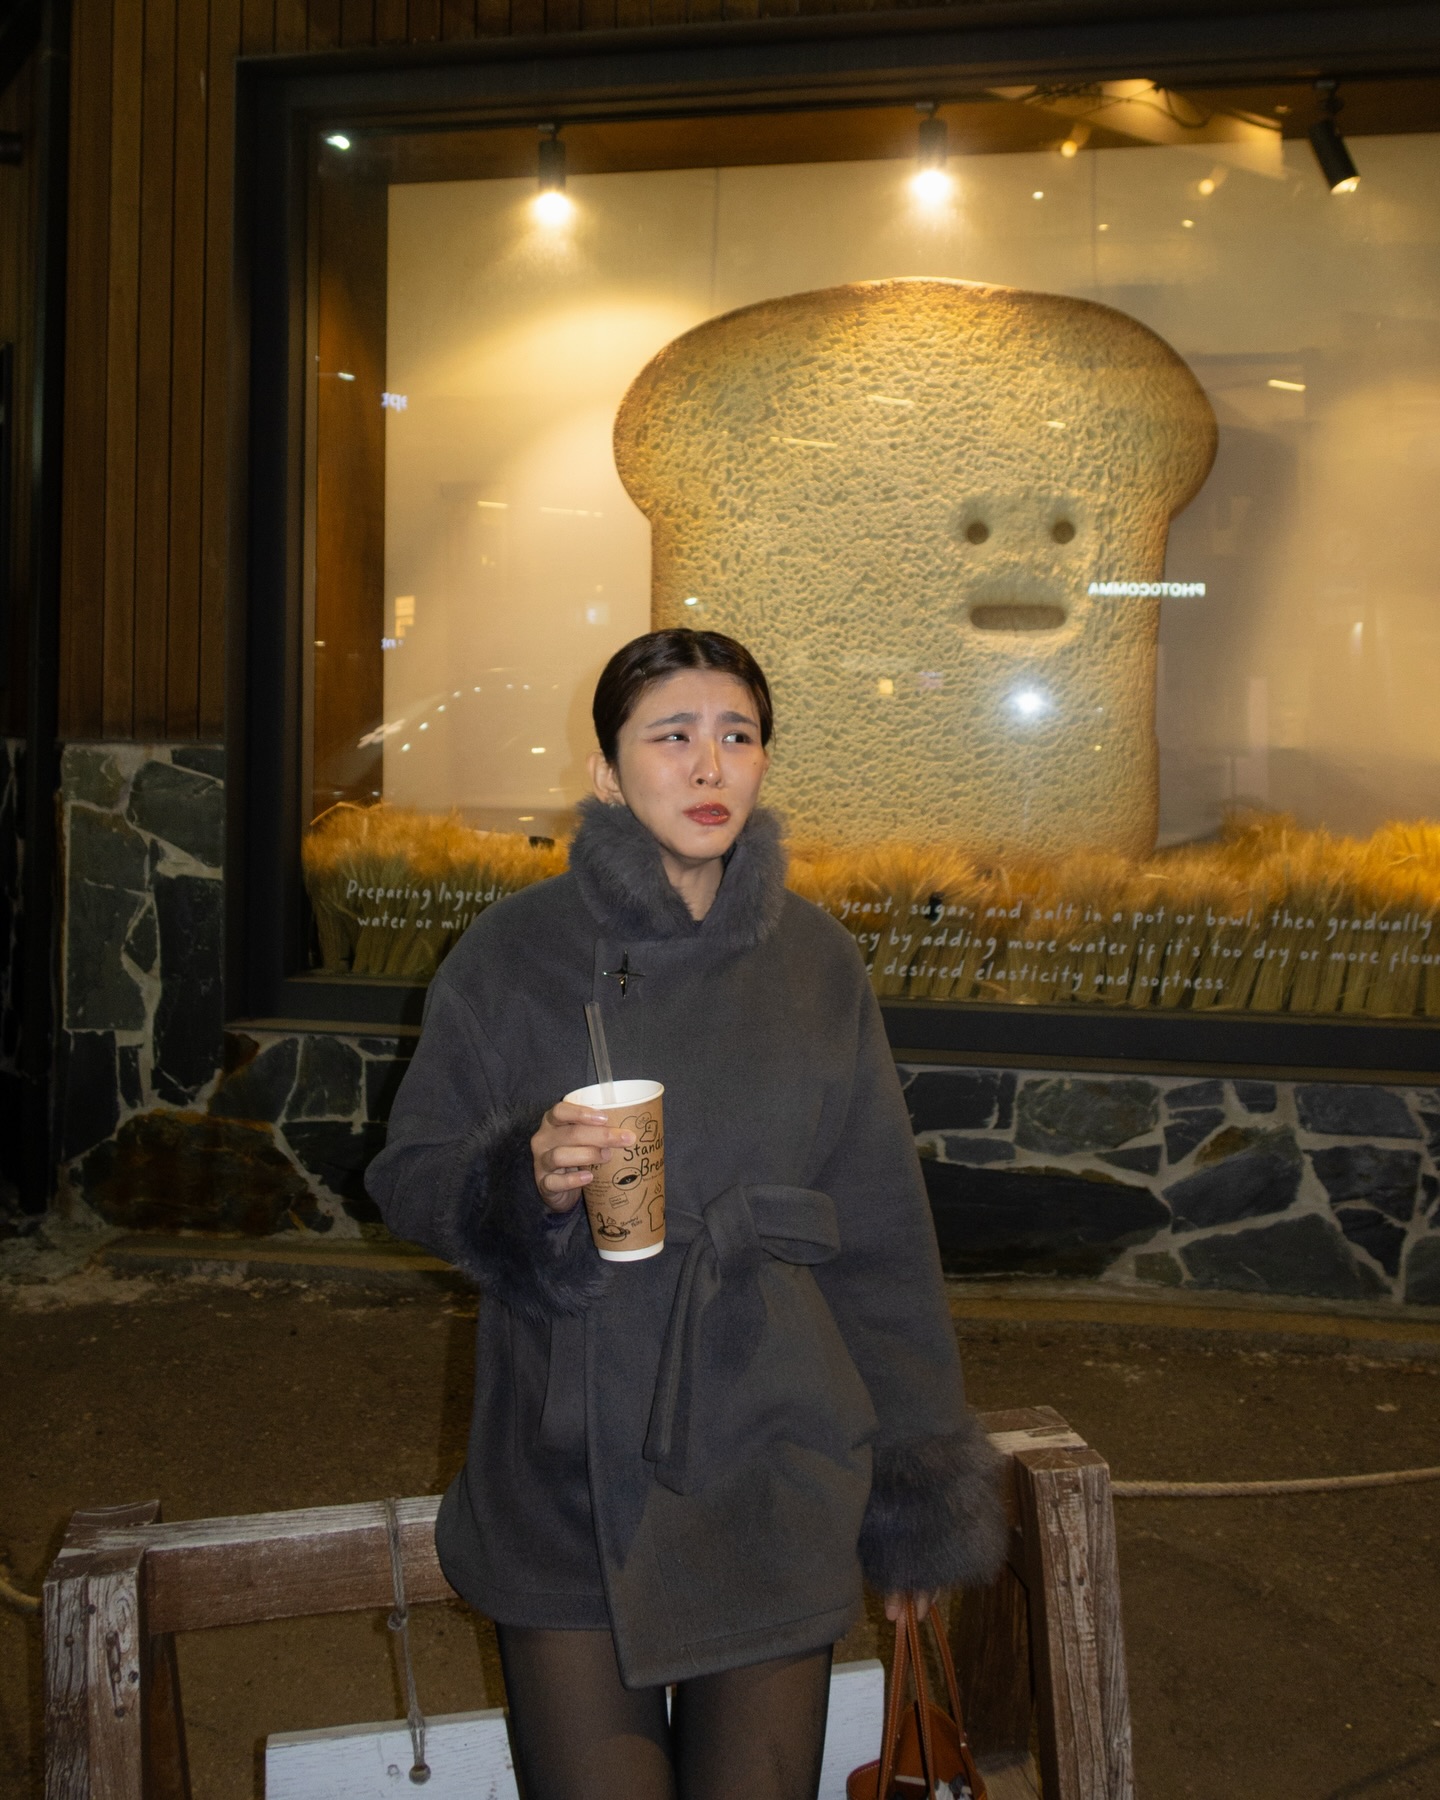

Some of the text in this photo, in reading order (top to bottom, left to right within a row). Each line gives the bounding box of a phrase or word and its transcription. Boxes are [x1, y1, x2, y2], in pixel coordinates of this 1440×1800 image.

[346, 880, 431, 910] Preparing
[840, 896, 899, 920] yeast,
[910, 901, 975, 926] sugar,
[985, 901, 1022, 920] and
[1034, 902, 1074, 921] salt
[1085, 905, 1102, 922] in
[1112, 911, 1123, 923] a
[1132, 906, 1165, 929] pot
[1175, 912, 1195, 925] or
[1206, 907, 1260, 930] bowl,
[1272, 909, 1315, 929] then
[1326, 912, 1432, 941] gradually
[357, 911, 407, 929] water
[416, 918, 431, 929] or
[889, 927, 911, 952] by
[921, 929, 998, 959] adding
[1008, 938, 1056, 952] more
[1067, 937, 1128, 955] water
[1137, 937, 1156, 963] if
[1165, 937, 1201, 957] it's
[1210, 940, 1242, 958] too
[1253, 941, 1290, 967] dry
[1300, 949, 1320, 961] or
[1330, 950, 1380, 964] more
[884, 957, 965, 978] desired
[974, 962, 1084, 992] elasticity
[1094, 966, 1130, 986] and
